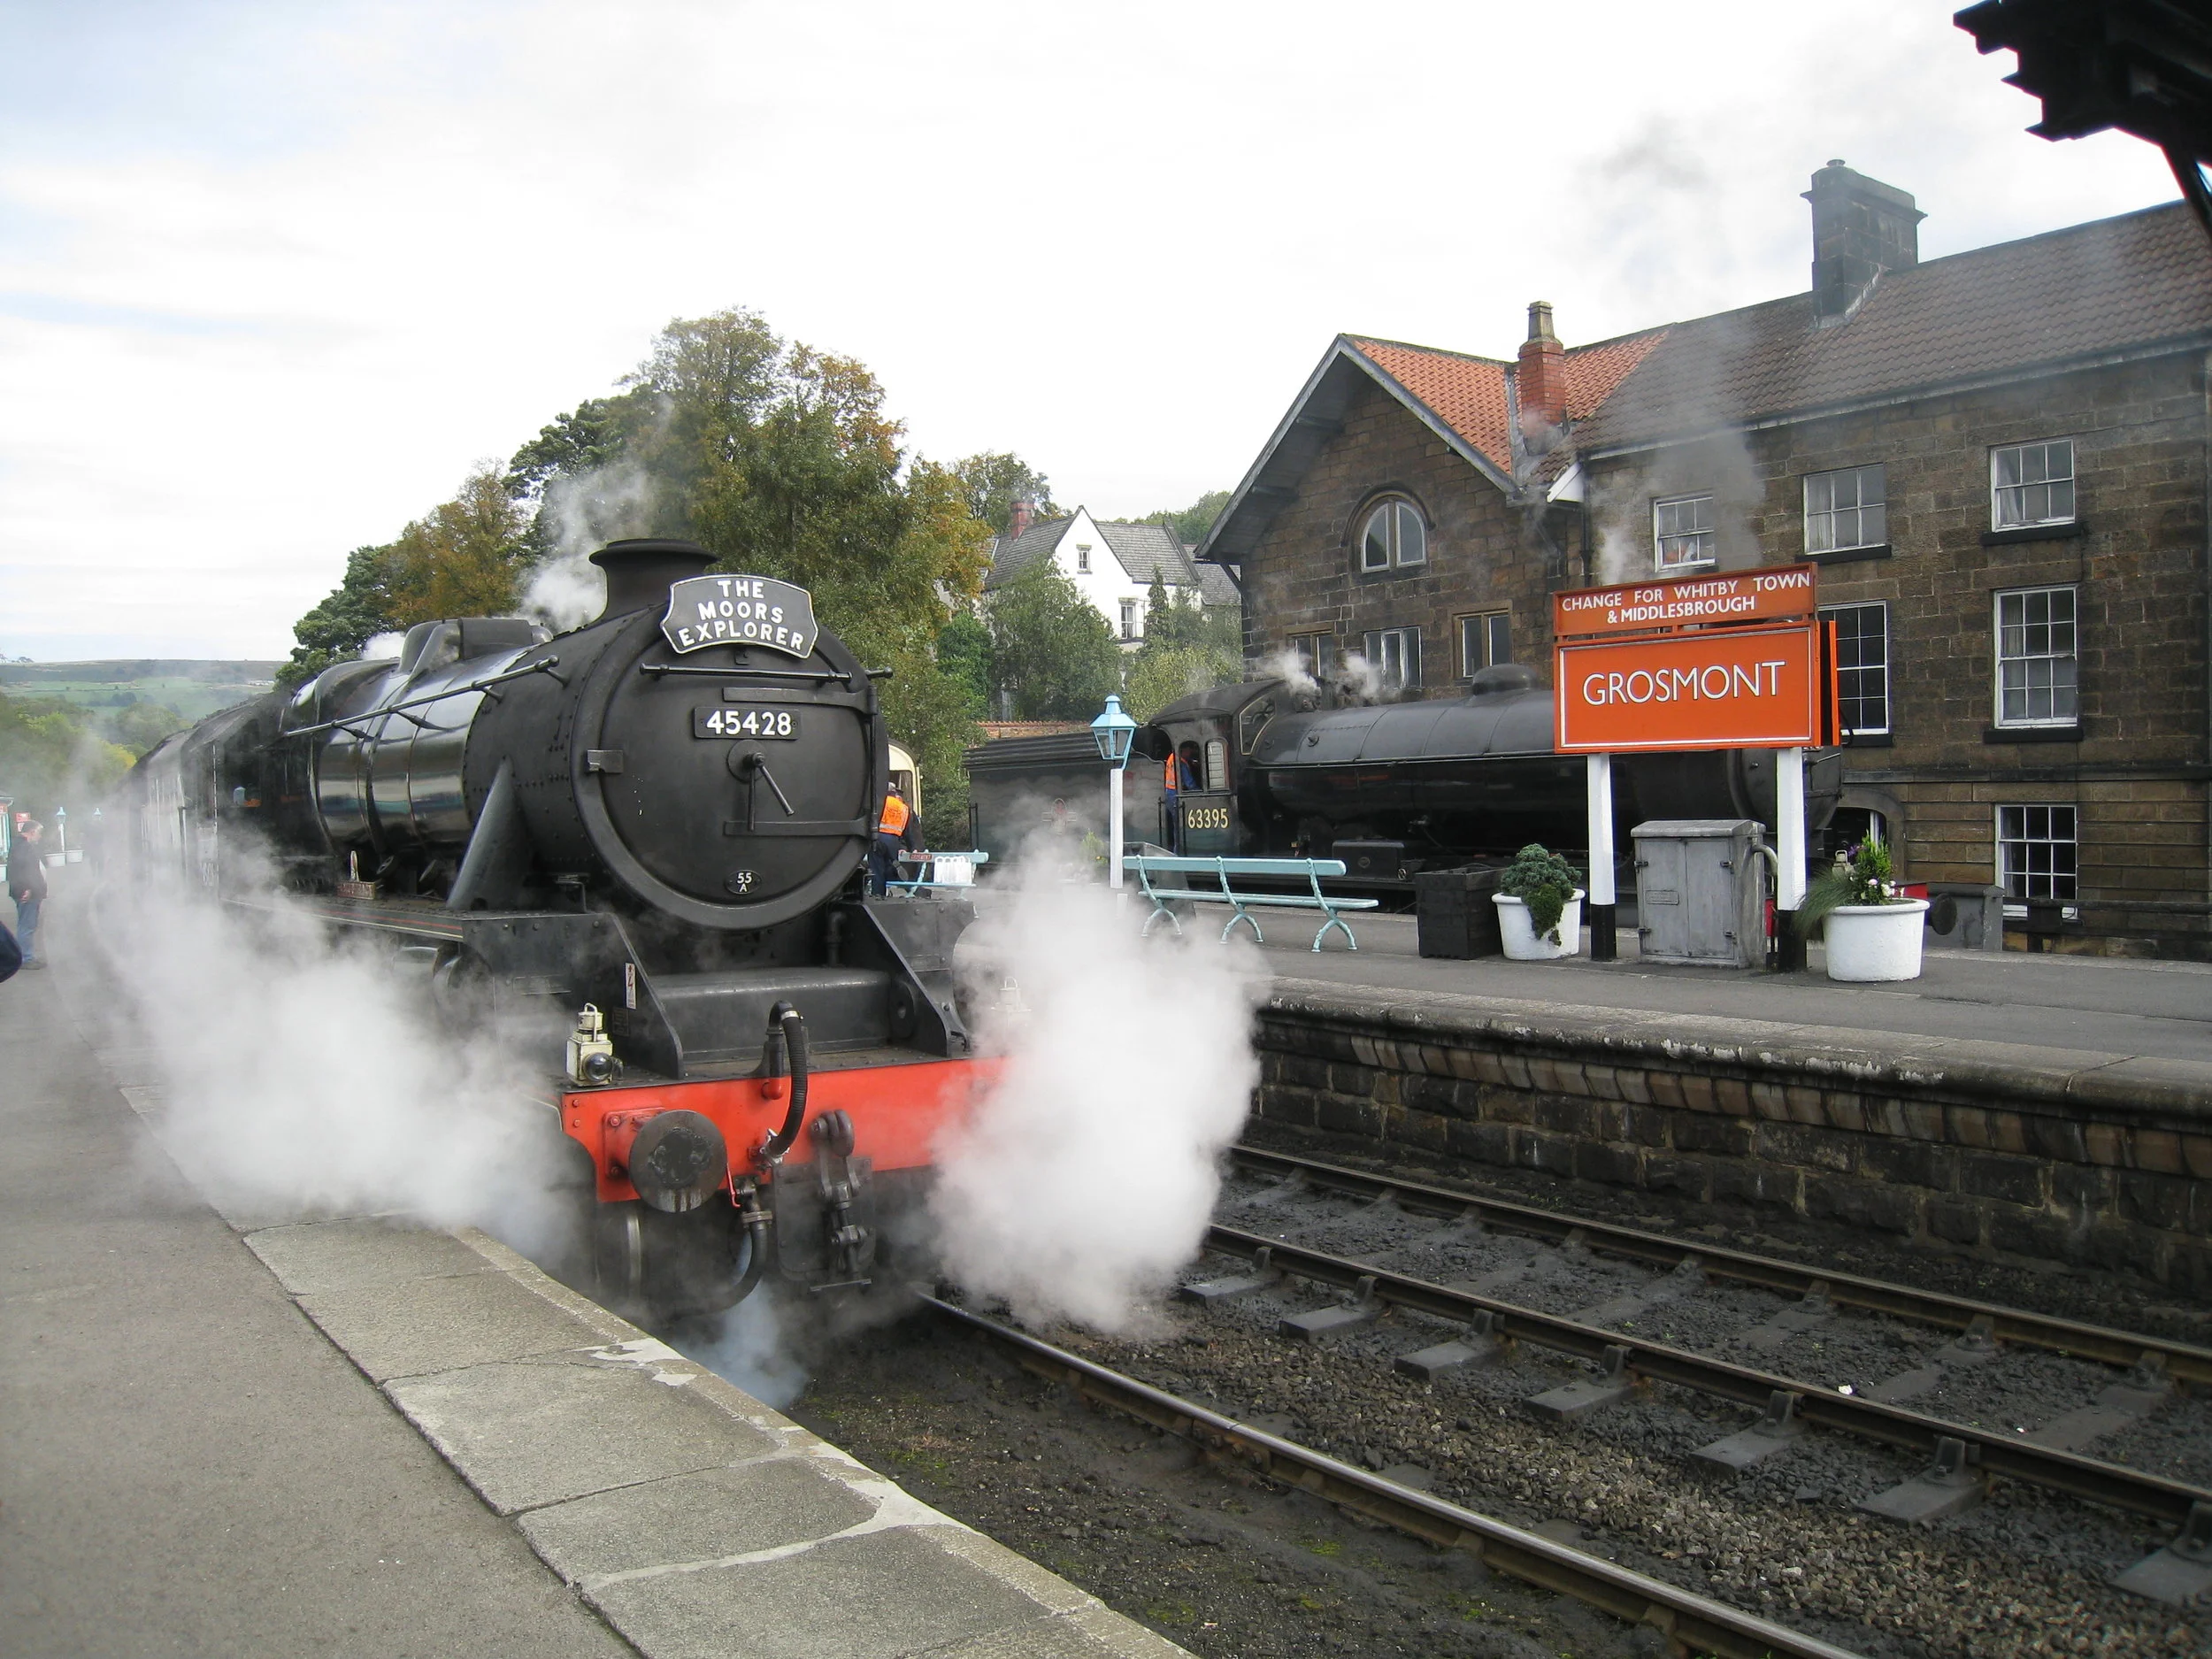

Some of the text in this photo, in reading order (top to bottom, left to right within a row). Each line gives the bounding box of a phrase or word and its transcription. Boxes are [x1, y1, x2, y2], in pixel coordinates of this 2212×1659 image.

[717, 580, 764, 599] THE
[1562, 572, 1810, 611] CHANGE FOR WHITBY TOWN
[697, 600, 784, 624] MOORS
[1607, 596, 1755, 624] & MIDDLESBROUGH
[678, 620, 804, 650] EXPLORER
[1582, 660, 1786, 706] GROSMONT
[706, 710, 792, 736] 45428
[1187, 808, 1228, 829] 63395
[736, 872, 752, 884] 55
[739, 884, 749, 893] A
